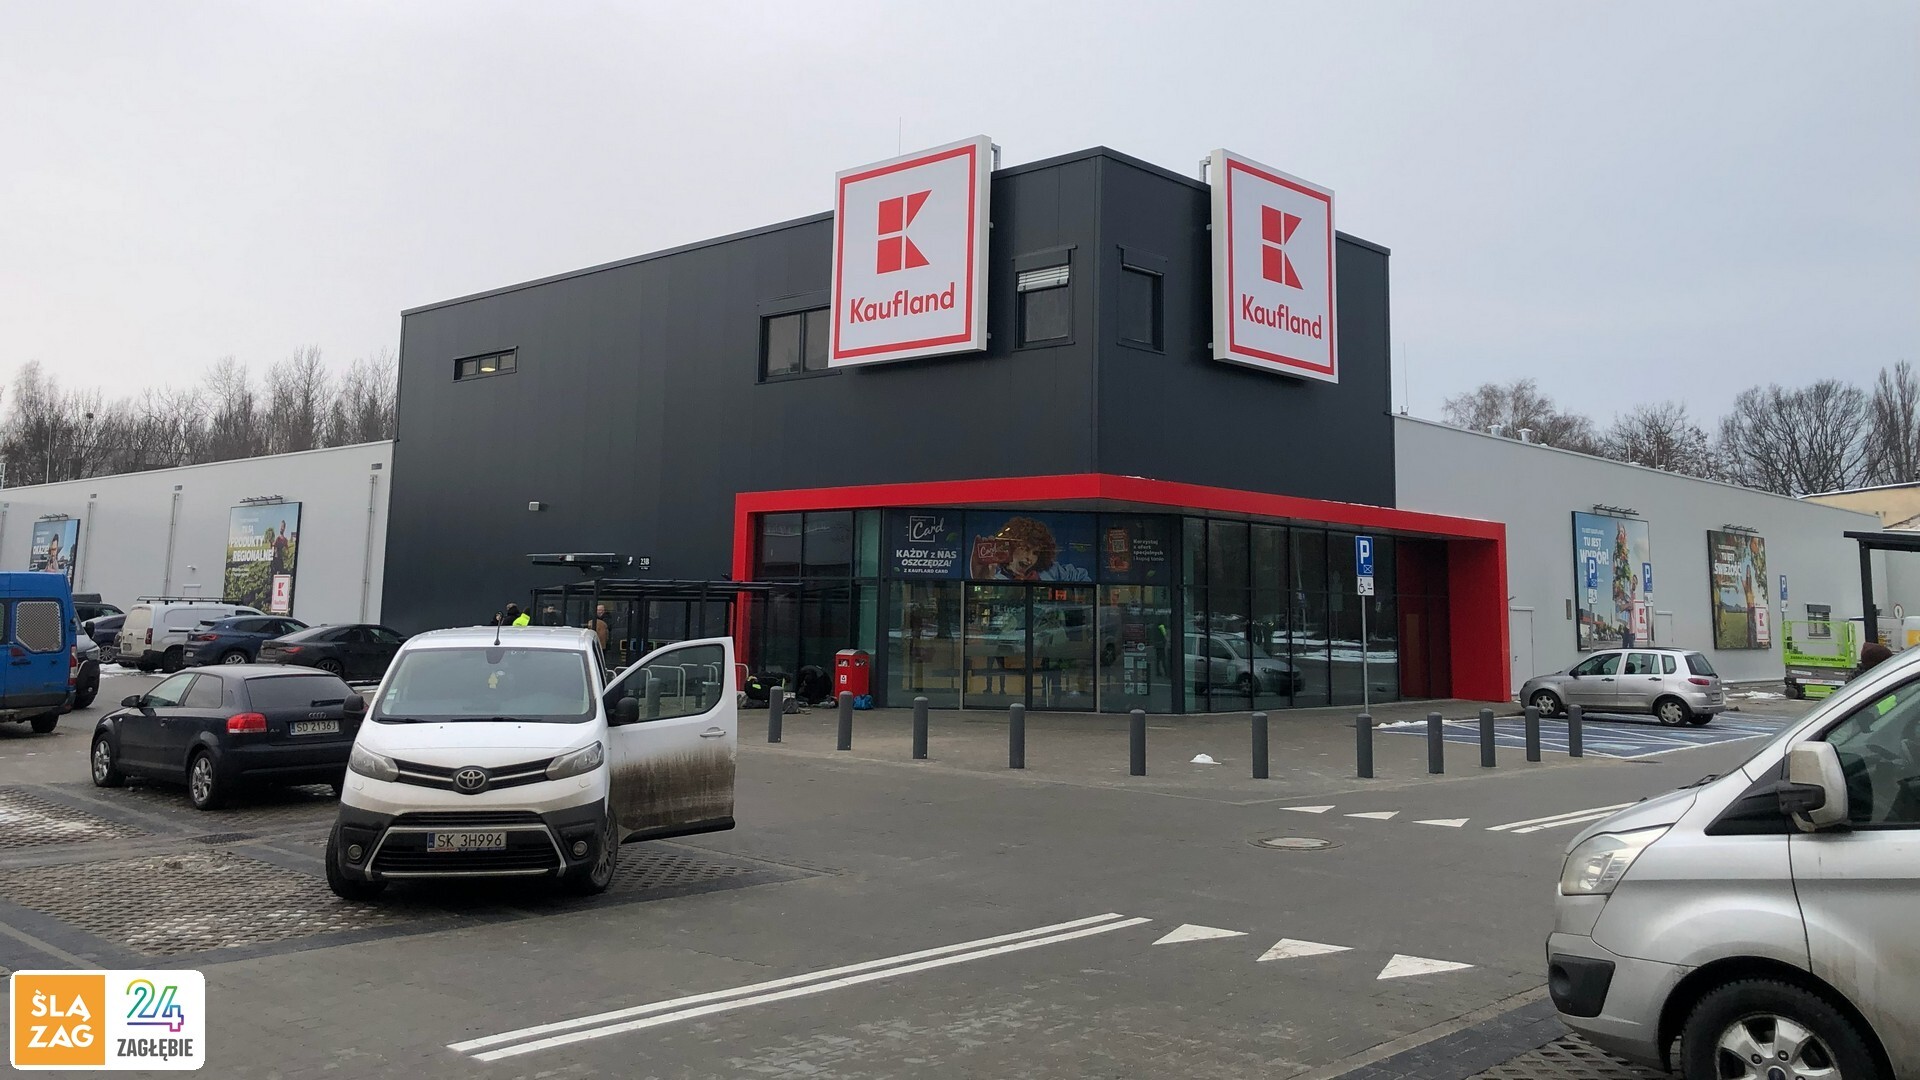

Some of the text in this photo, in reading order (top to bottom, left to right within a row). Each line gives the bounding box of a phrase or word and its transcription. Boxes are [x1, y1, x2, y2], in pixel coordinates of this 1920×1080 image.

[850, 281, 955, 324] Kaufland
[1242, 293, 1322, 340] Kaufland
[913, 517, 945, 539] Card
[229, 535, 265, 548] PRODUKTY
[1583, 536, 1591, 547] TU
[896, 548, 929, 558] KAŻDY
[937, 550, 957, 559] NAS
[1360, 540, 1370, 564] P
[901, 558, 952, 568] OSZCZĘDZA!
[1589, 560, 1596, 578] P
[1644, 565, 1651, 583] P
[296, 723, 309, 732] SD
[437, 833, 502, 848] SK 3H996
